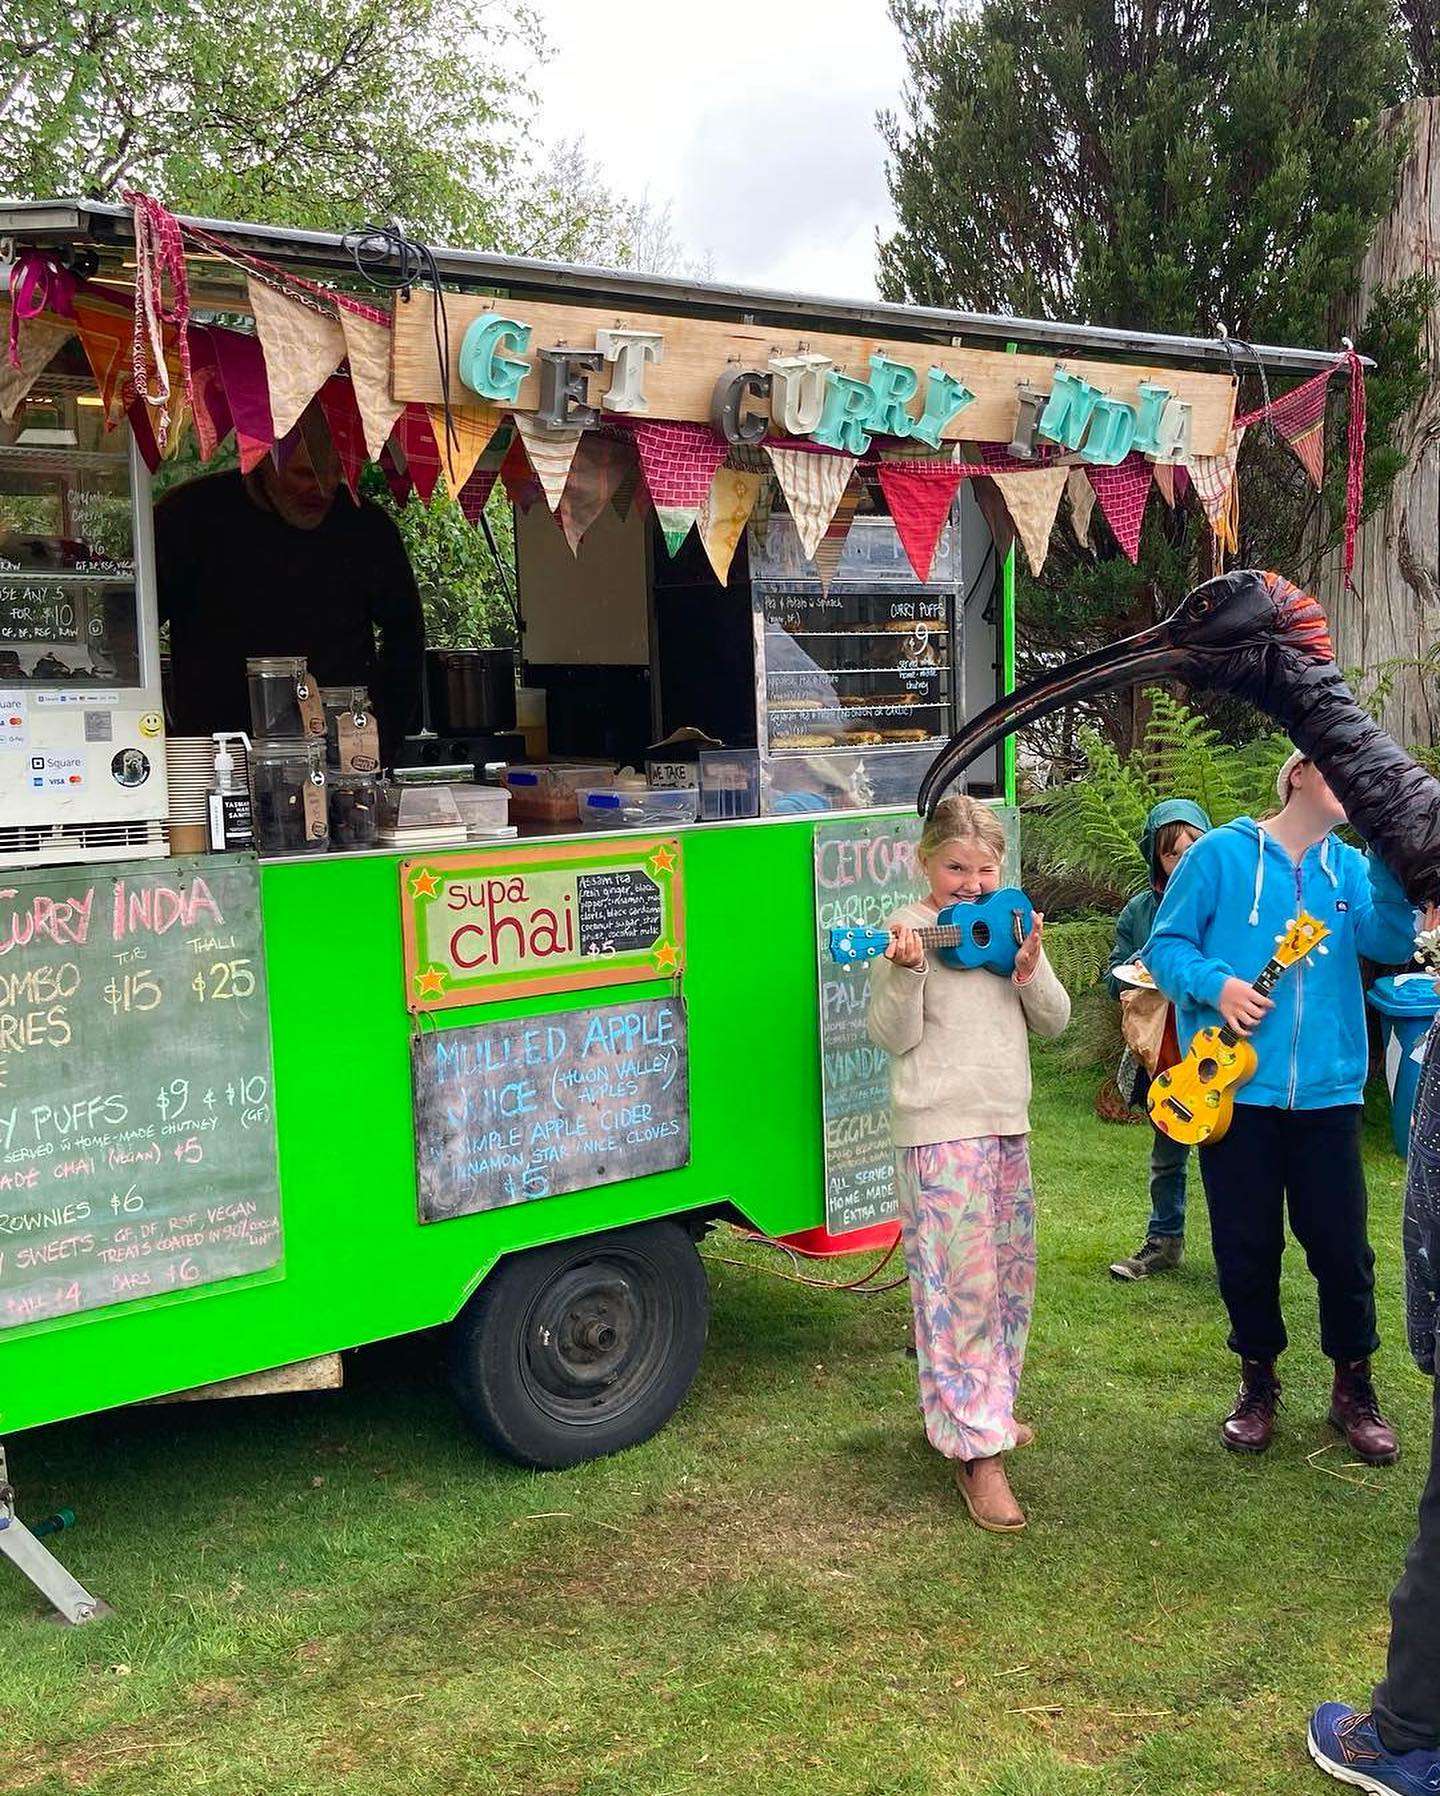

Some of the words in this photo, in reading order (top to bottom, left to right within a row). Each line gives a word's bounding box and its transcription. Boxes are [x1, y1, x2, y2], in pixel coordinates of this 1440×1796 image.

[459, 312, 663, 431] GET
[711, 353, 977, 456] CURRY
[997, 370, 1193, 466] INDIA
[23, 587, 47, 603] ANY
[891, 603, 915, 619] CURRY
[920, 602, 945, 617] PUFFS
[10, 607, 33, 620] FOR
[42, 604, 73, 627] $10
[47, 758, 81, 769] Square
[664, 765, 686, 779] TAKE
[113, 876, 226, 942] INDIA
[448, 877, 529, 911] supa
[186, 935, 237, 954] THALI
[450, 895, 573, 969] chai
[588, 939, 616, 960] $5
[103, 970, 162, 1015] $15
[192, 959, 256, 1002] $25
[434, 1026, 567, 1085] MULLED
[581, 1009, 677, 1059] APPLE
[614, 1046, 678, 1090] VALLEY)
[31, 1094, 129, 1141] PUFFS
[156, 1078, 189, 1121] $9
[225, 1076, 267, 1107] $10
[531, 1115, 588, 1145] APPLE
[600, 1103, 652, 1131] CIDER
[4, 1142, 54, 1164] SERVED
[74, 1123, 155, 1150] HOME-MADE
[161, 1116, 218, 1136] CHUTNEY
[240, 1103, 270, 1130] (GF)
[626, 1119, 680, 1144] CLOVES
[53, 1157, 95, 1180] CHAI
[108, 1141, 162, 1171] (VEGAN)
[173, 1136, 203, 1164] $5
[503, 1165, 549, 1200] $5
[829, 1177, 850, 1194] ALL
[109, 1184, 145, 1216] $6
[16, 1233, 95, 1269] SWEETS
[207, 1200, 256, 1225] VEGAN
[97, 1241, 152, 1264] TREATS
[157, 1230, 204, 1253] COATED
